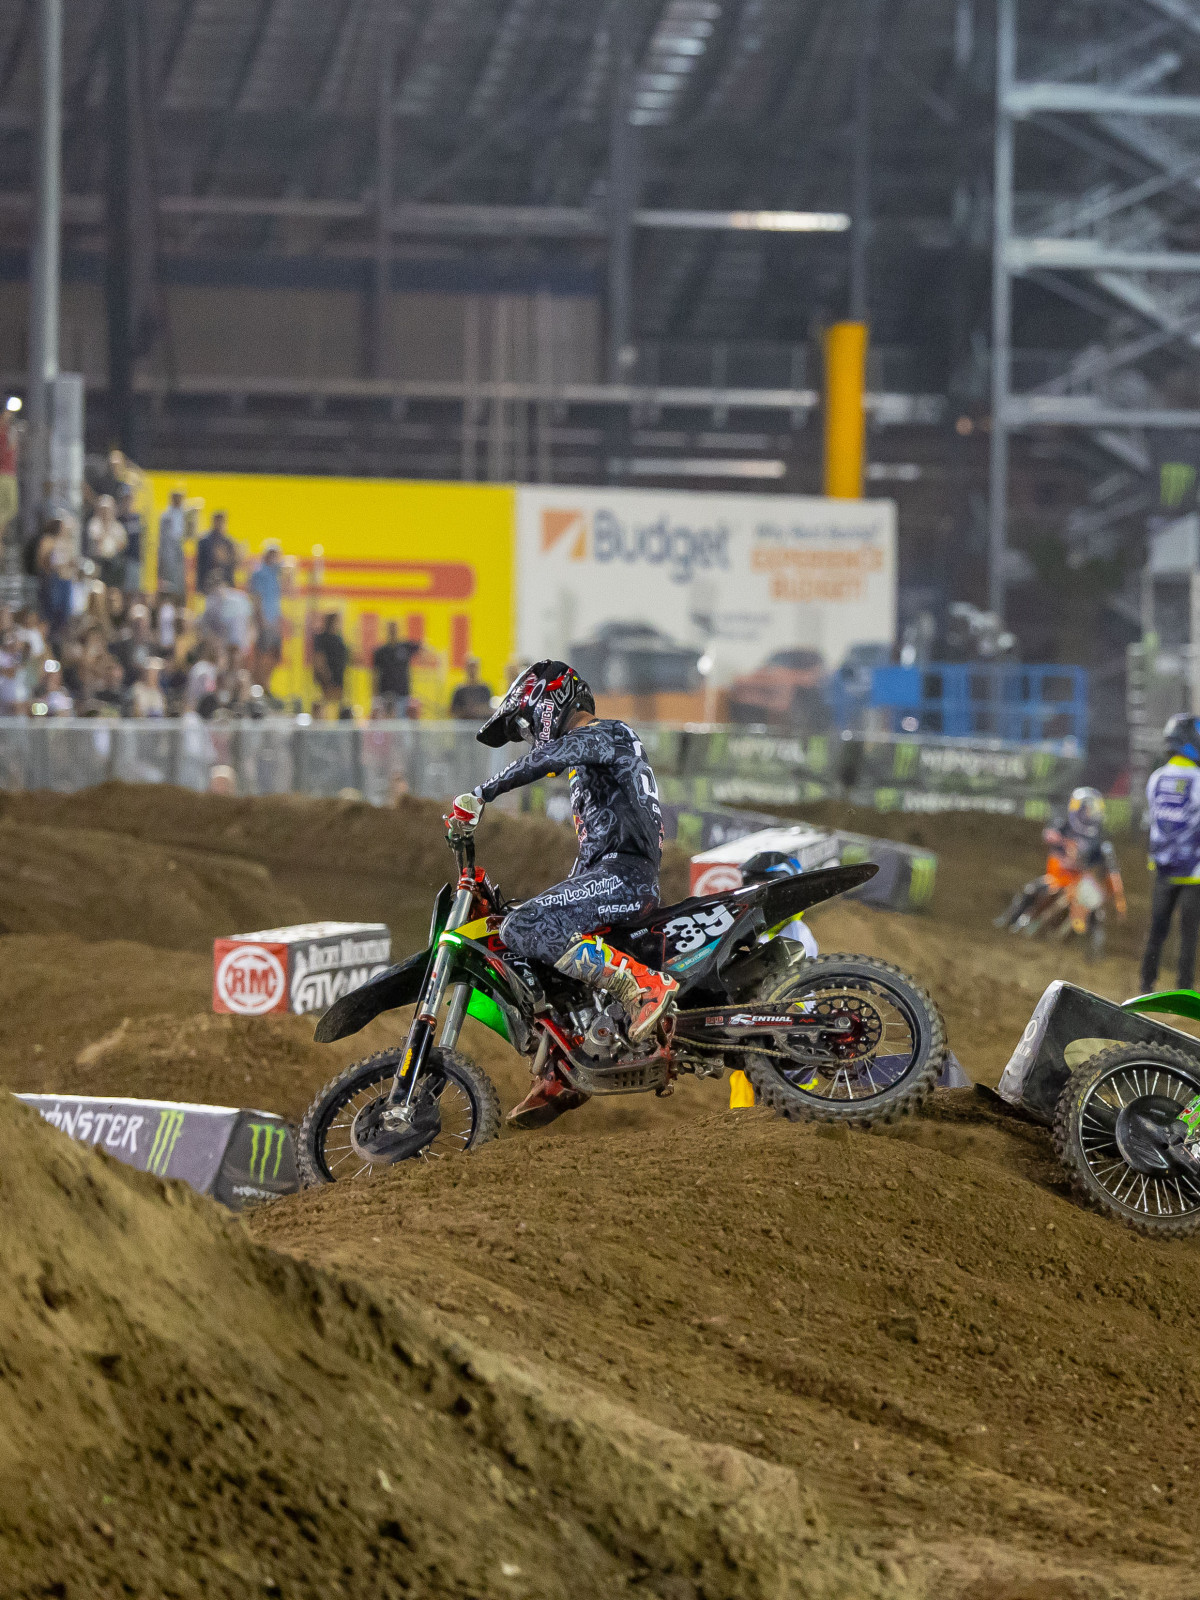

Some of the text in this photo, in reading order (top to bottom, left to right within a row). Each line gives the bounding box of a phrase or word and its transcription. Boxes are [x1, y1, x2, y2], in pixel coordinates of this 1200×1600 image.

[593, 508, 732, 586] Budget
[565, 888, 587, 902] Lee
[597, 901, 641, 915] GASGAS
[663, 904, 735, 953] 39
